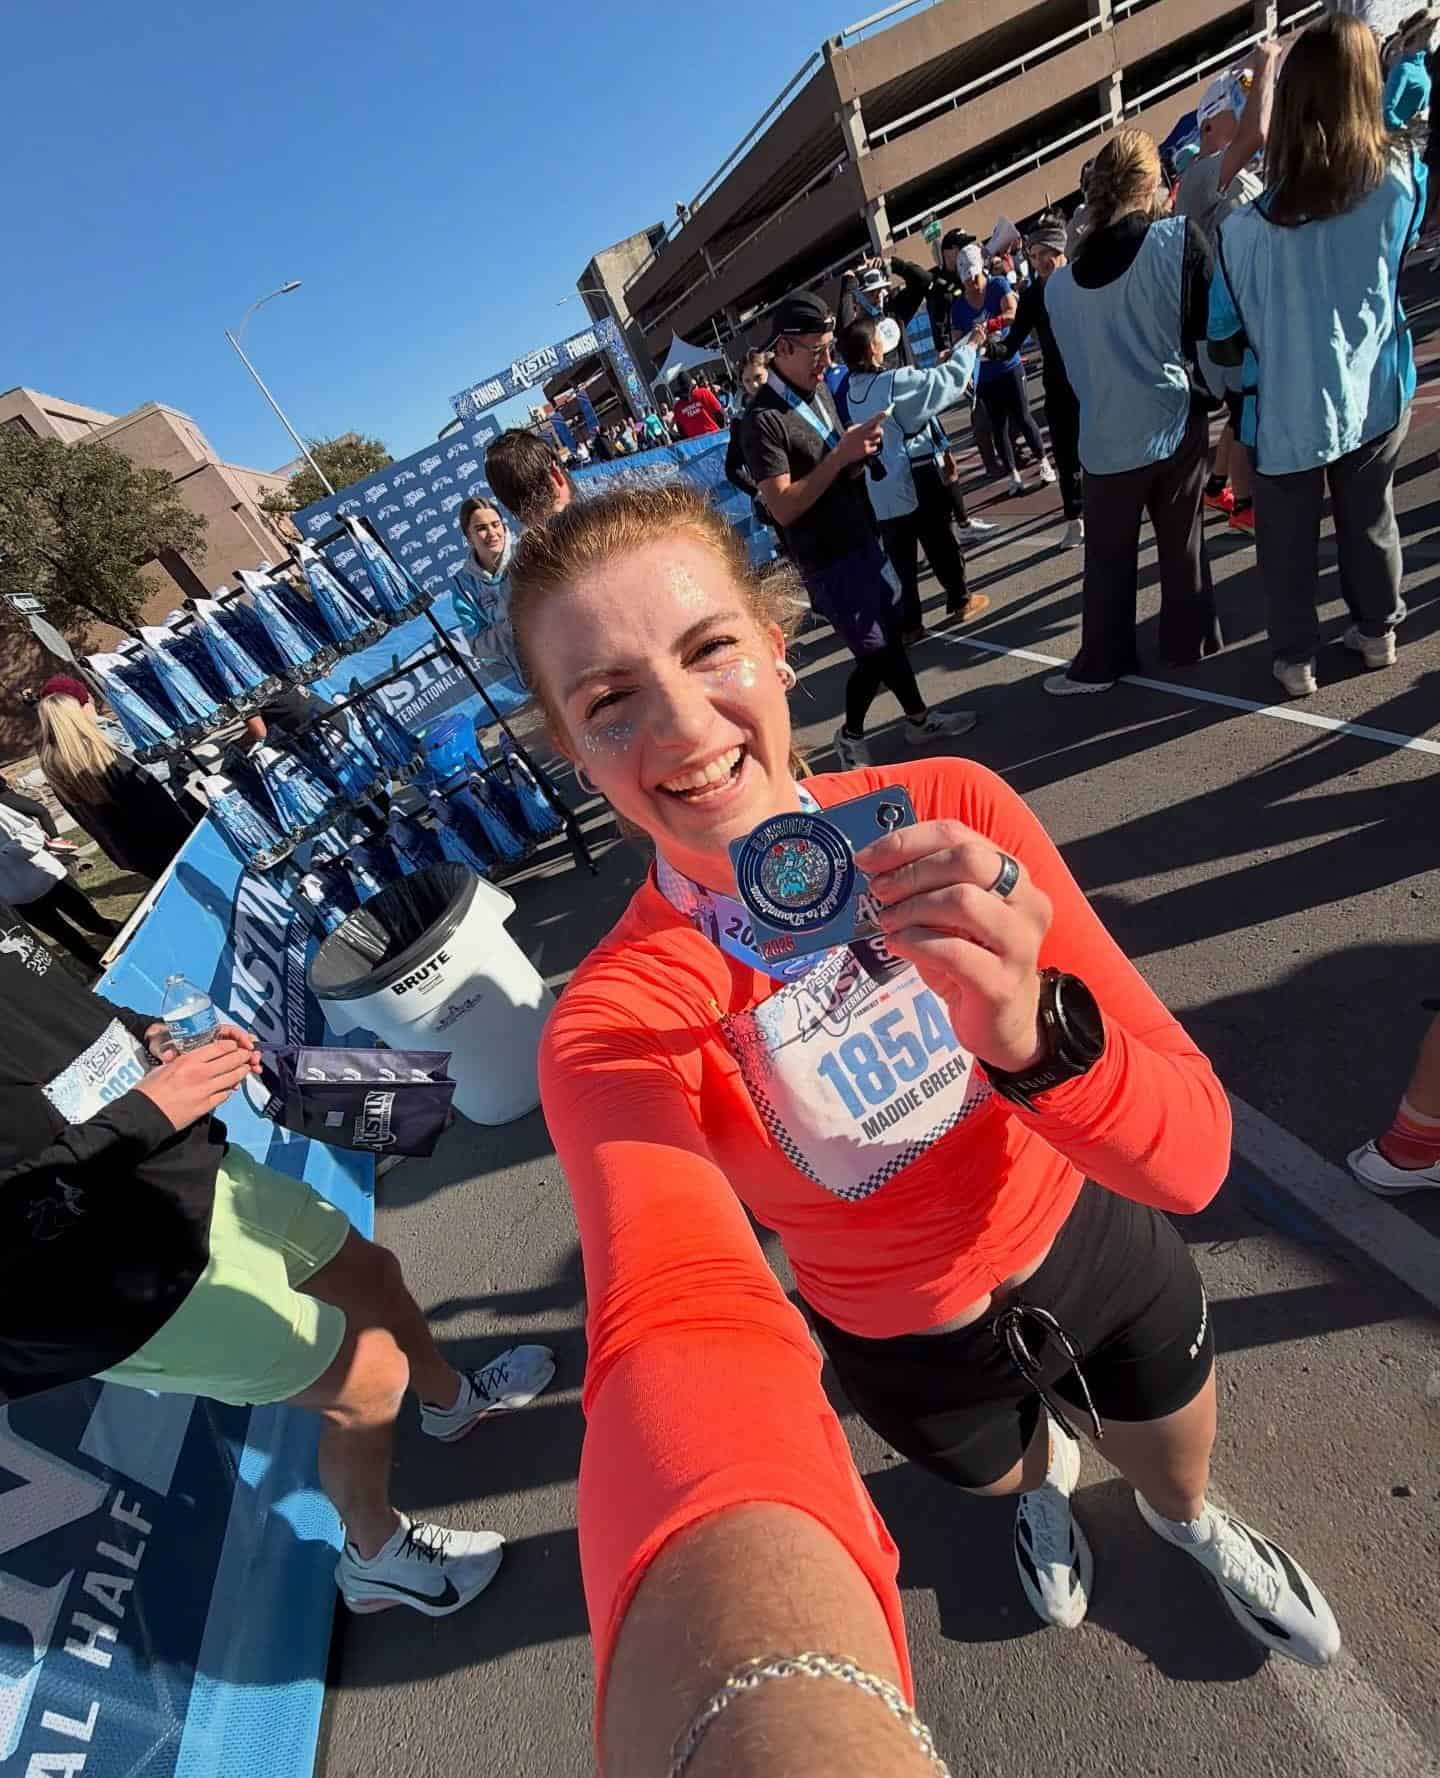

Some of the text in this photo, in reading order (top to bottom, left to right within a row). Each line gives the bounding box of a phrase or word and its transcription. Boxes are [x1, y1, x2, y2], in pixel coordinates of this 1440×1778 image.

[470, 378, 506, 409] FINISH
[511, 346, 560, 389] AUSTIN
[566, 331, 600, 360] FINISH
[395, 674, 457, 726] TERNATIONAL
[391, 950, 450, 996] BRUTE
[834, 980, 879, 1021] INTERNATIO
[817, 989, 960, 1120] 1854
[353, 1090, 397, 1151] AUSTIN
[861, 1087, 923, 1140] MADDIE
[919, 1054, 967, 1099] GREEN
[63, 1490, 152, 1669] HALF
